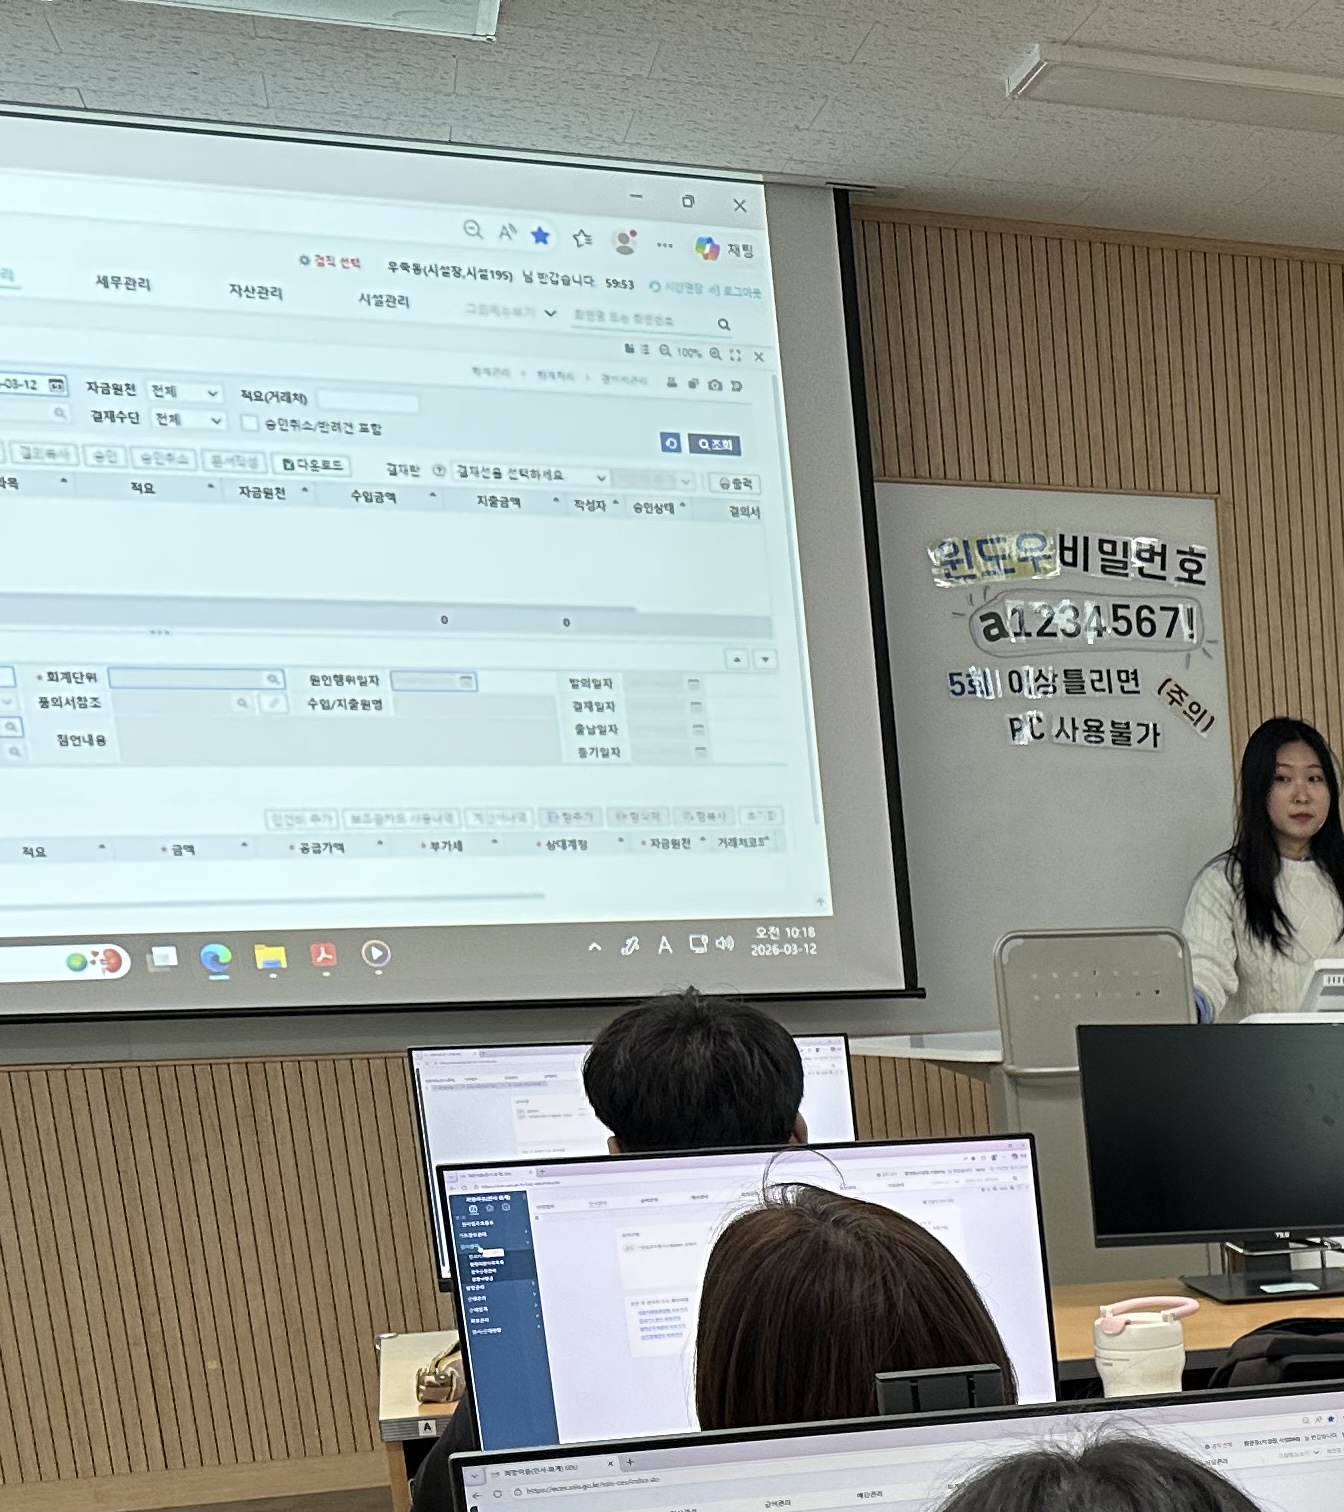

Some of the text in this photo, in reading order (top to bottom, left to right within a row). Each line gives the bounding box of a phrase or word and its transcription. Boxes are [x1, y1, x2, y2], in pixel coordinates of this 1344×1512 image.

[96, 274, 152, 292] 세무관리
[605, 277, 636, 291] 59:53
[229, 283, 284, 301] 자산관리
[358, 291, 411, 310] 시설관리
[86, 380, 138, 397] 자금원천
[151, 385, 178, 399] 전체
[155, 413, 183, 428] 전체
[296, 458, 345, 473] 다운로드
[131, 481, 156, 496] 적요
[351, 490, 398, 506] 수입금액
[1058, 532, 1208, 587] 비밀번호
[978, 603, 1197, 643] a1234567!
[46, 670, 98, 685] 회계단위
[1157, 676, 1216, 735] (주의)
[1007, 715, 1162, 749] PC 사용불가
[22, 845, 48, 860] 적요
[171, 843, 196, 857] 금액
[755, 926, 817, 941] 오전 10:18
[751, 941, 818, 958] 2026-03-12
[423, 1421, 432, 1432] A
